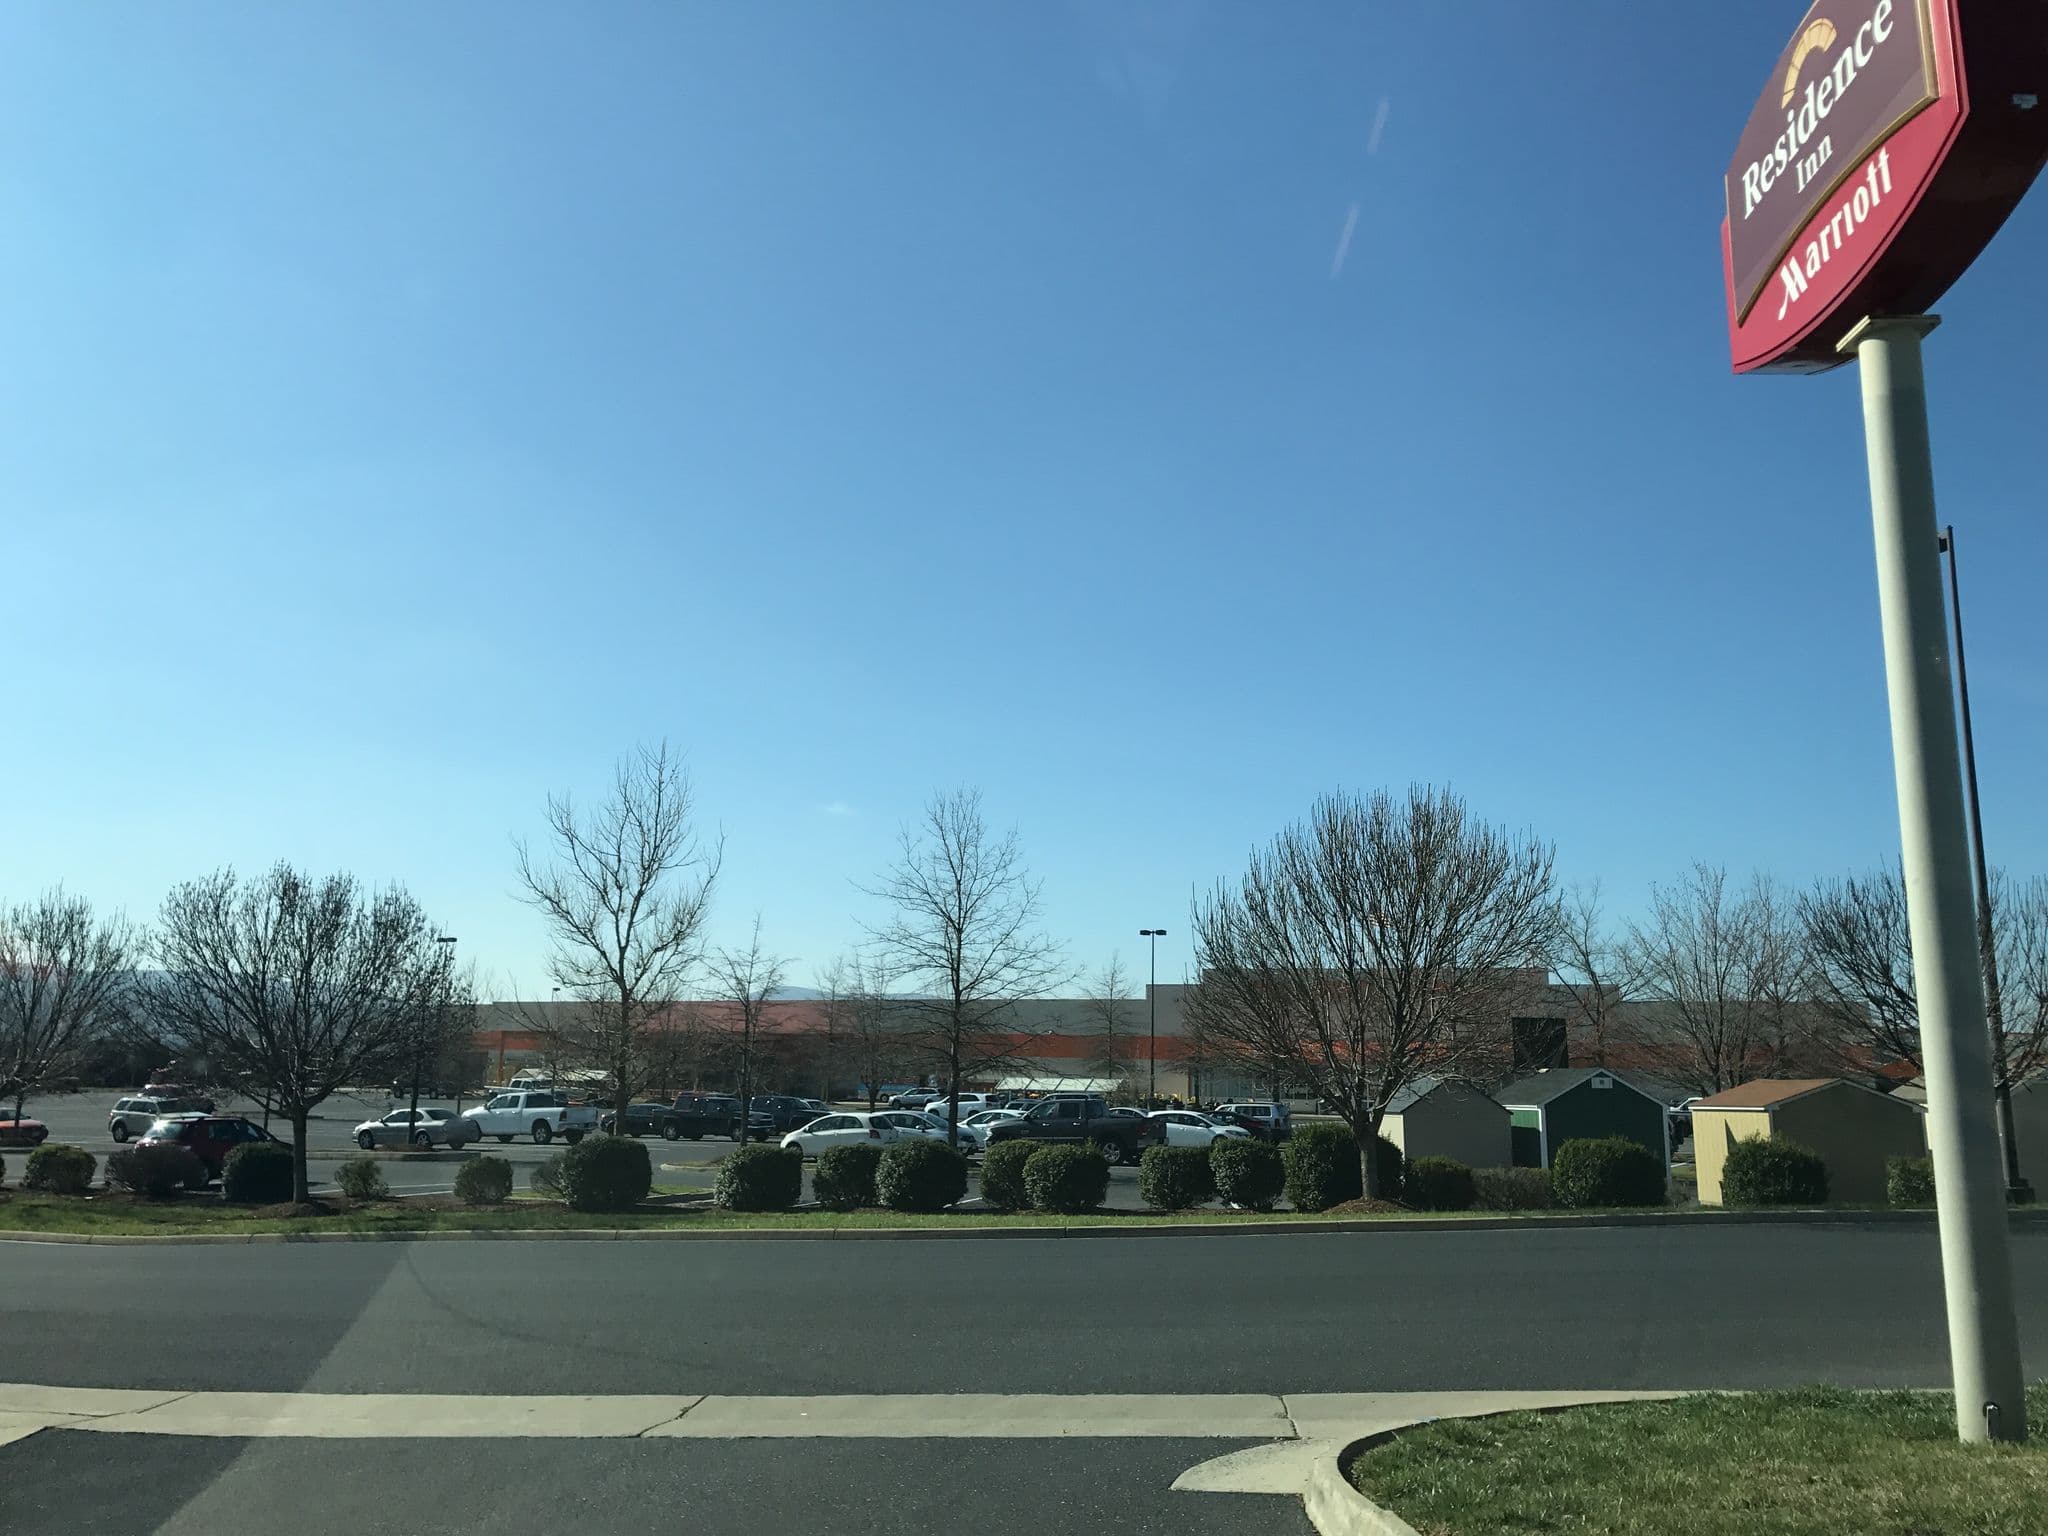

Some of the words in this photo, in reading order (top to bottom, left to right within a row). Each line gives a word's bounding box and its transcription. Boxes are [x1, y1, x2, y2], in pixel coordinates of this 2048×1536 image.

[1741, 0, 1894, 219] Residence
[1796, 135, 1834, 194] Inn
[1778, 147, 1893, 320] Marriott
